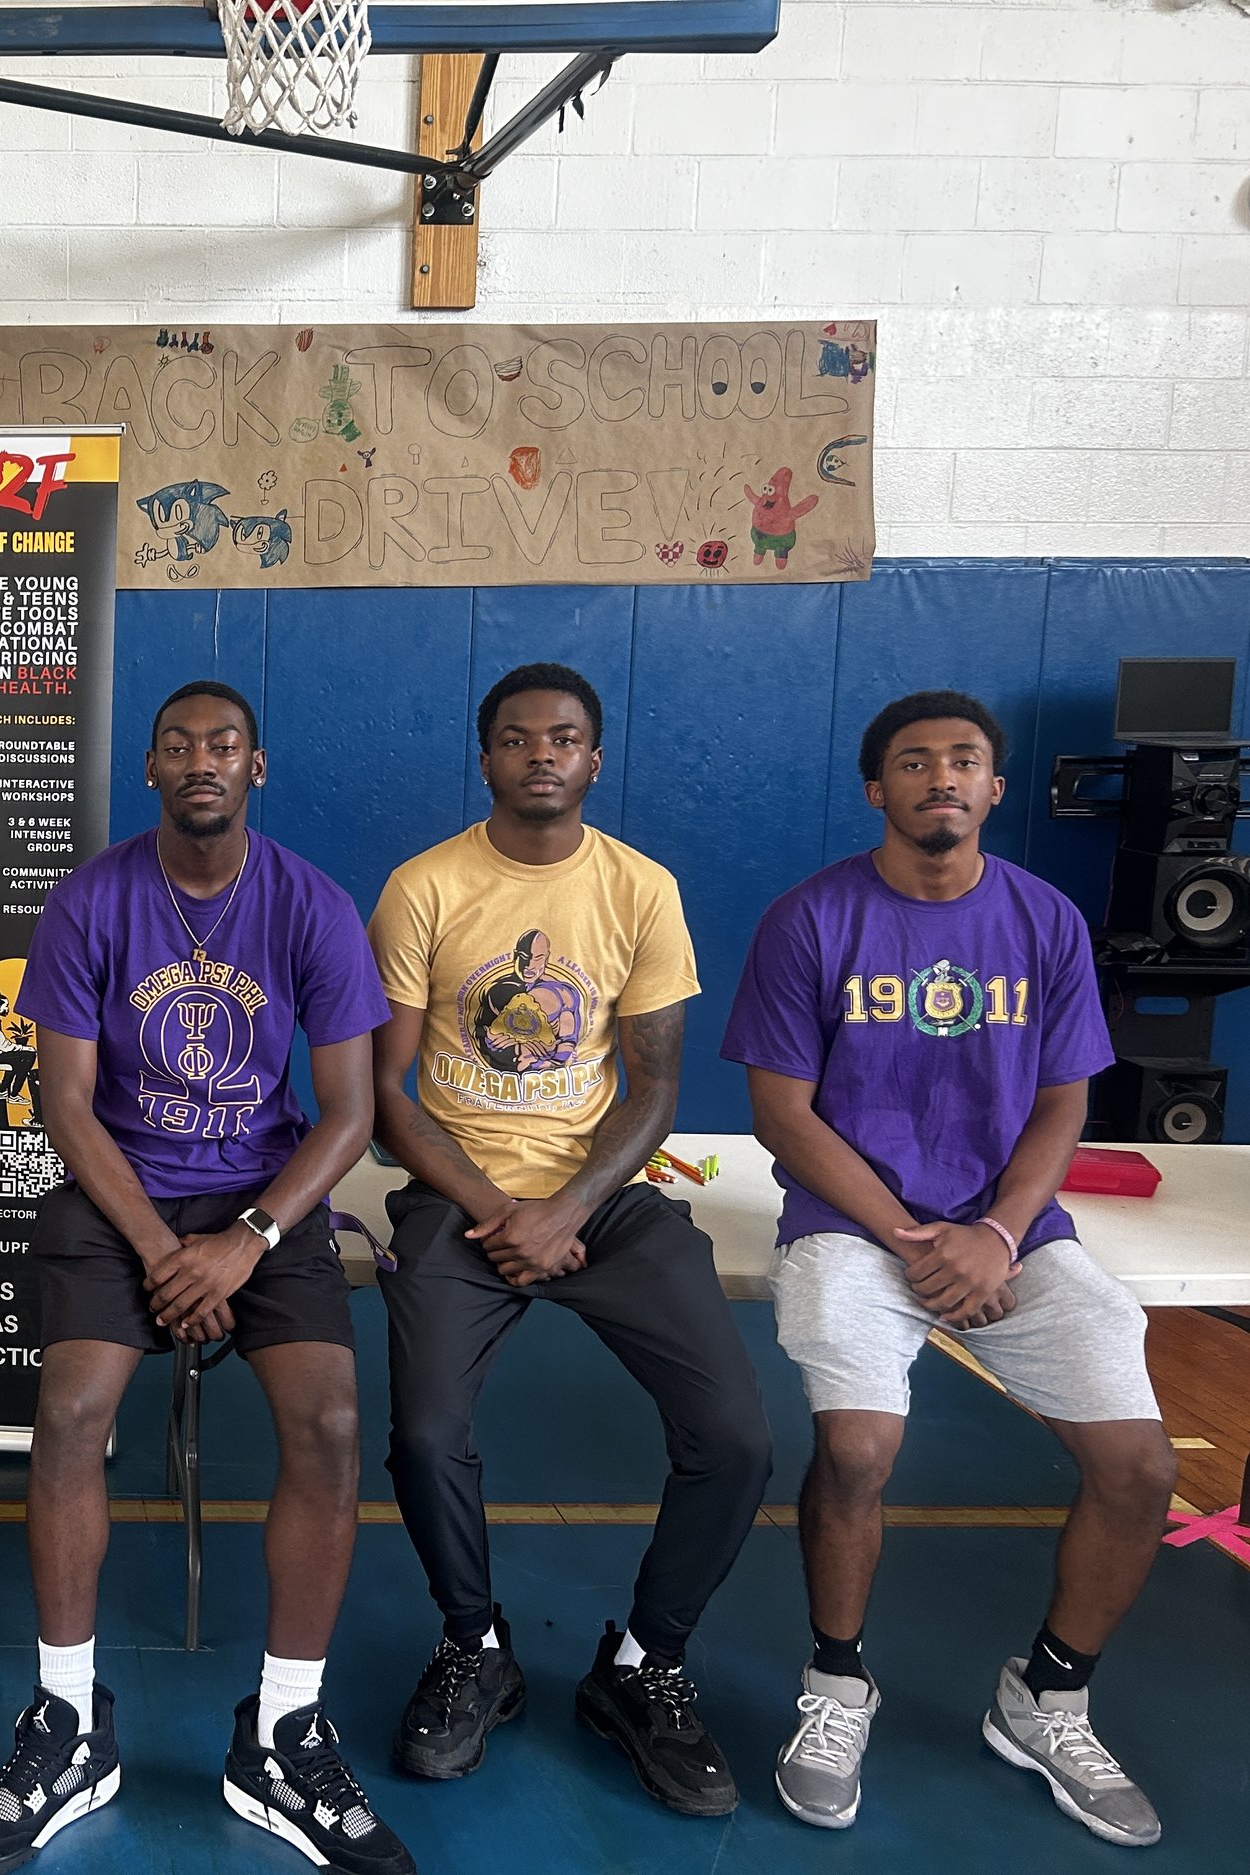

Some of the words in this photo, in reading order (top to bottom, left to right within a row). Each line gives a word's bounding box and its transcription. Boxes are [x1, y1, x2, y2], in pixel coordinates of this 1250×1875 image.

[19, 350, 281, 453] BACK
[342, 343, 494, 439] TO
[518, 329, 850, 431] SCHOOL
[12, 531, 74, 553] CHANGE
[14, 577, 78, 590] YOUNG
[3, 591, 14, 605] &
[20, 592, 78, 605] TEENS
[16, 606, 78, 620] TOOLS
[0, 622, 78, 635] COMBAT
[17, 666, 76, 679] BLACK
[14, 715, 76, 725] INCLUDES:
[0, 779, 75, 789] INTERACTIVE
[1, 792, 75, 802] WORKSHOPS
[8, 817, 15, 826] 3
[18, 817, 26, 826] &
[28, 817, 35, 826] 6
[38, 818, 71, 827] WEEK
[10, 830, 71, 839] INTENSIVE
[27, 843, 74, 852] GROUPS
[10, 880, 59, 890] ACTIVIT
[466, 952, 511, 986] OVERNIGHT
[558, 956, 565, 964] A
[566, 961, 591, 987] LEADER
[129, 961, 196, 1012] OMEGA
[199, 961, 235, 987] PSI
[230, 971, 268, 1013] PHI
[844, 975, 905, 1022] 19
[986, 976, 1029, 1025] 11
[432, 1052, 523, 1104] OMEGA
[522, 1068, 568, 1102] PSI
